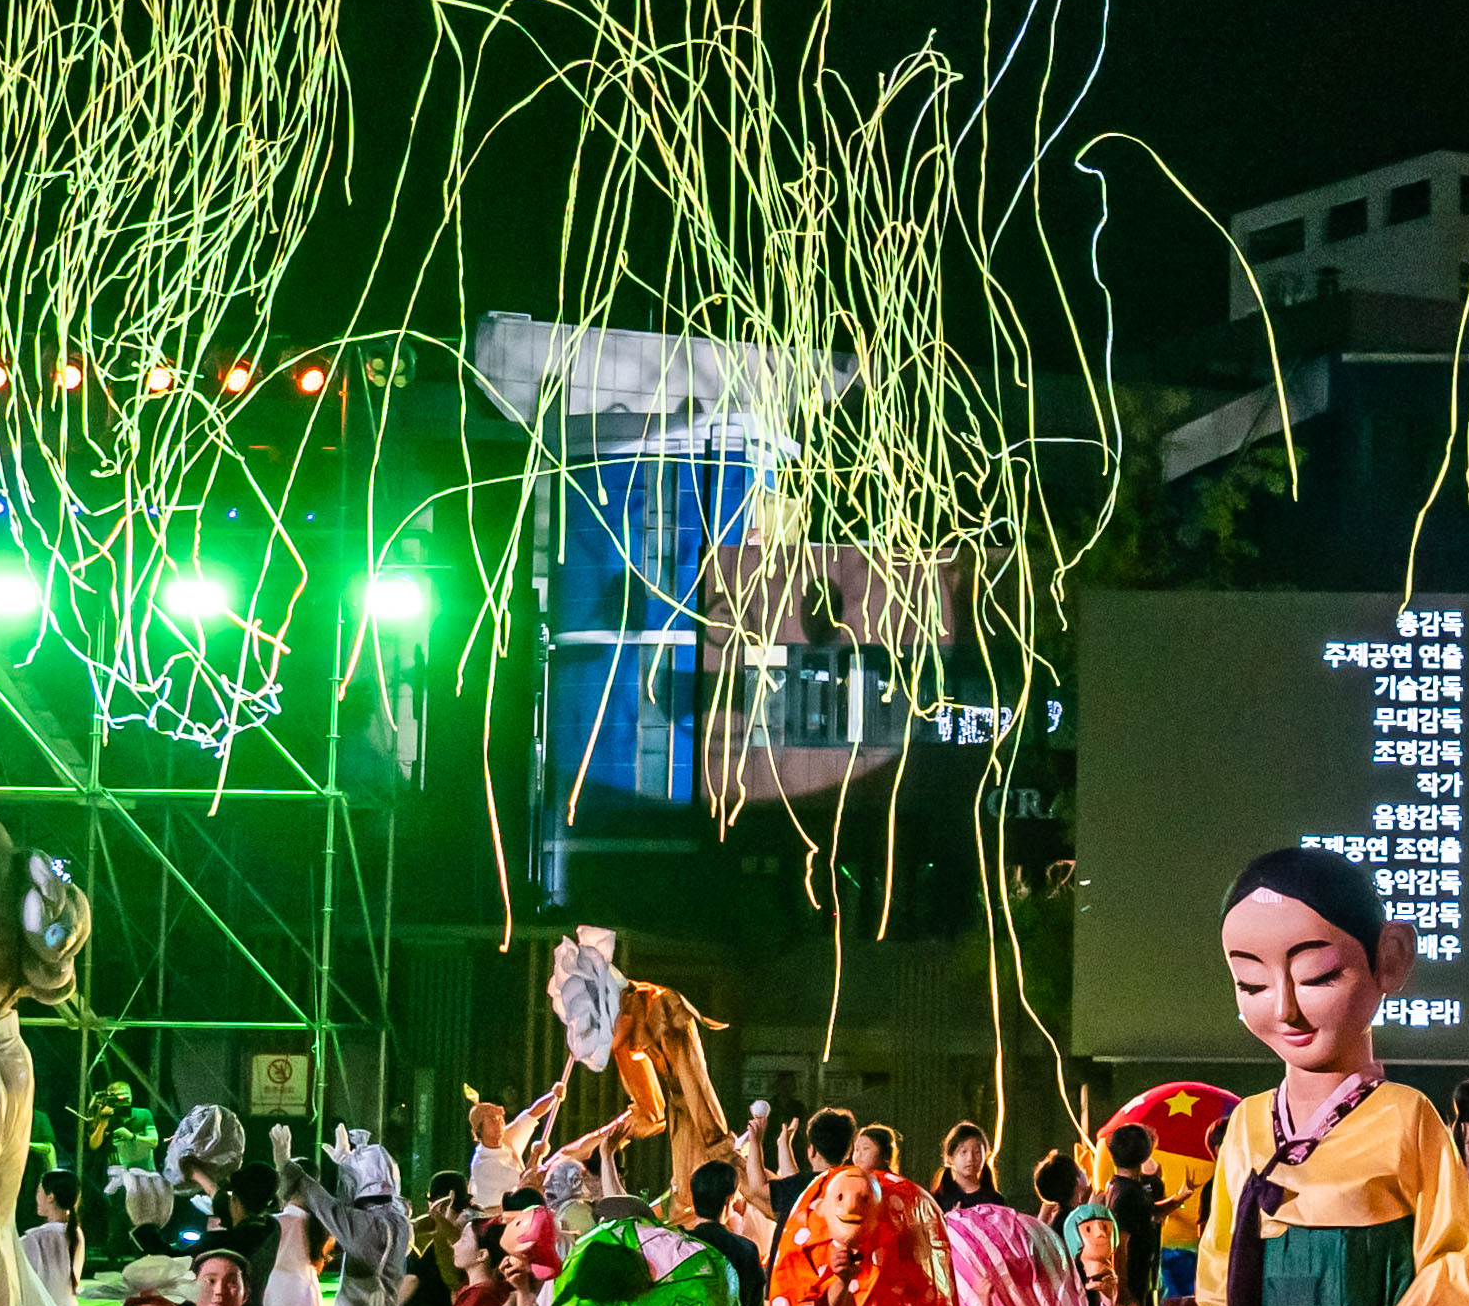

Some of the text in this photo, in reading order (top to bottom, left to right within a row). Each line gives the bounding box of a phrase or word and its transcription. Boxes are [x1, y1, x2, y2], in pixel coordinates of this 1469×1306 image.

[1396, 611, 1465, 638] 총감독
[1322, 642, 1413, 669] 주제공연
[1418, 643, 1464, 670] 연출
[1374, 674, 1464, 702] 기술감독
[1373, 707, 1464, 735] 무대감독
[1373, 739, 1463, 767] 조명감독
[1416, 771, 1464, 799] 작가
[986, 787, 1055, 820] CR
[1372, 804, 1463, 831] 음향감독
[1393, 836, 1463, 864] 조연출
[1372, 868, 1463, 896] 음악감독
[1417, 933, 1462, 961] 배우
